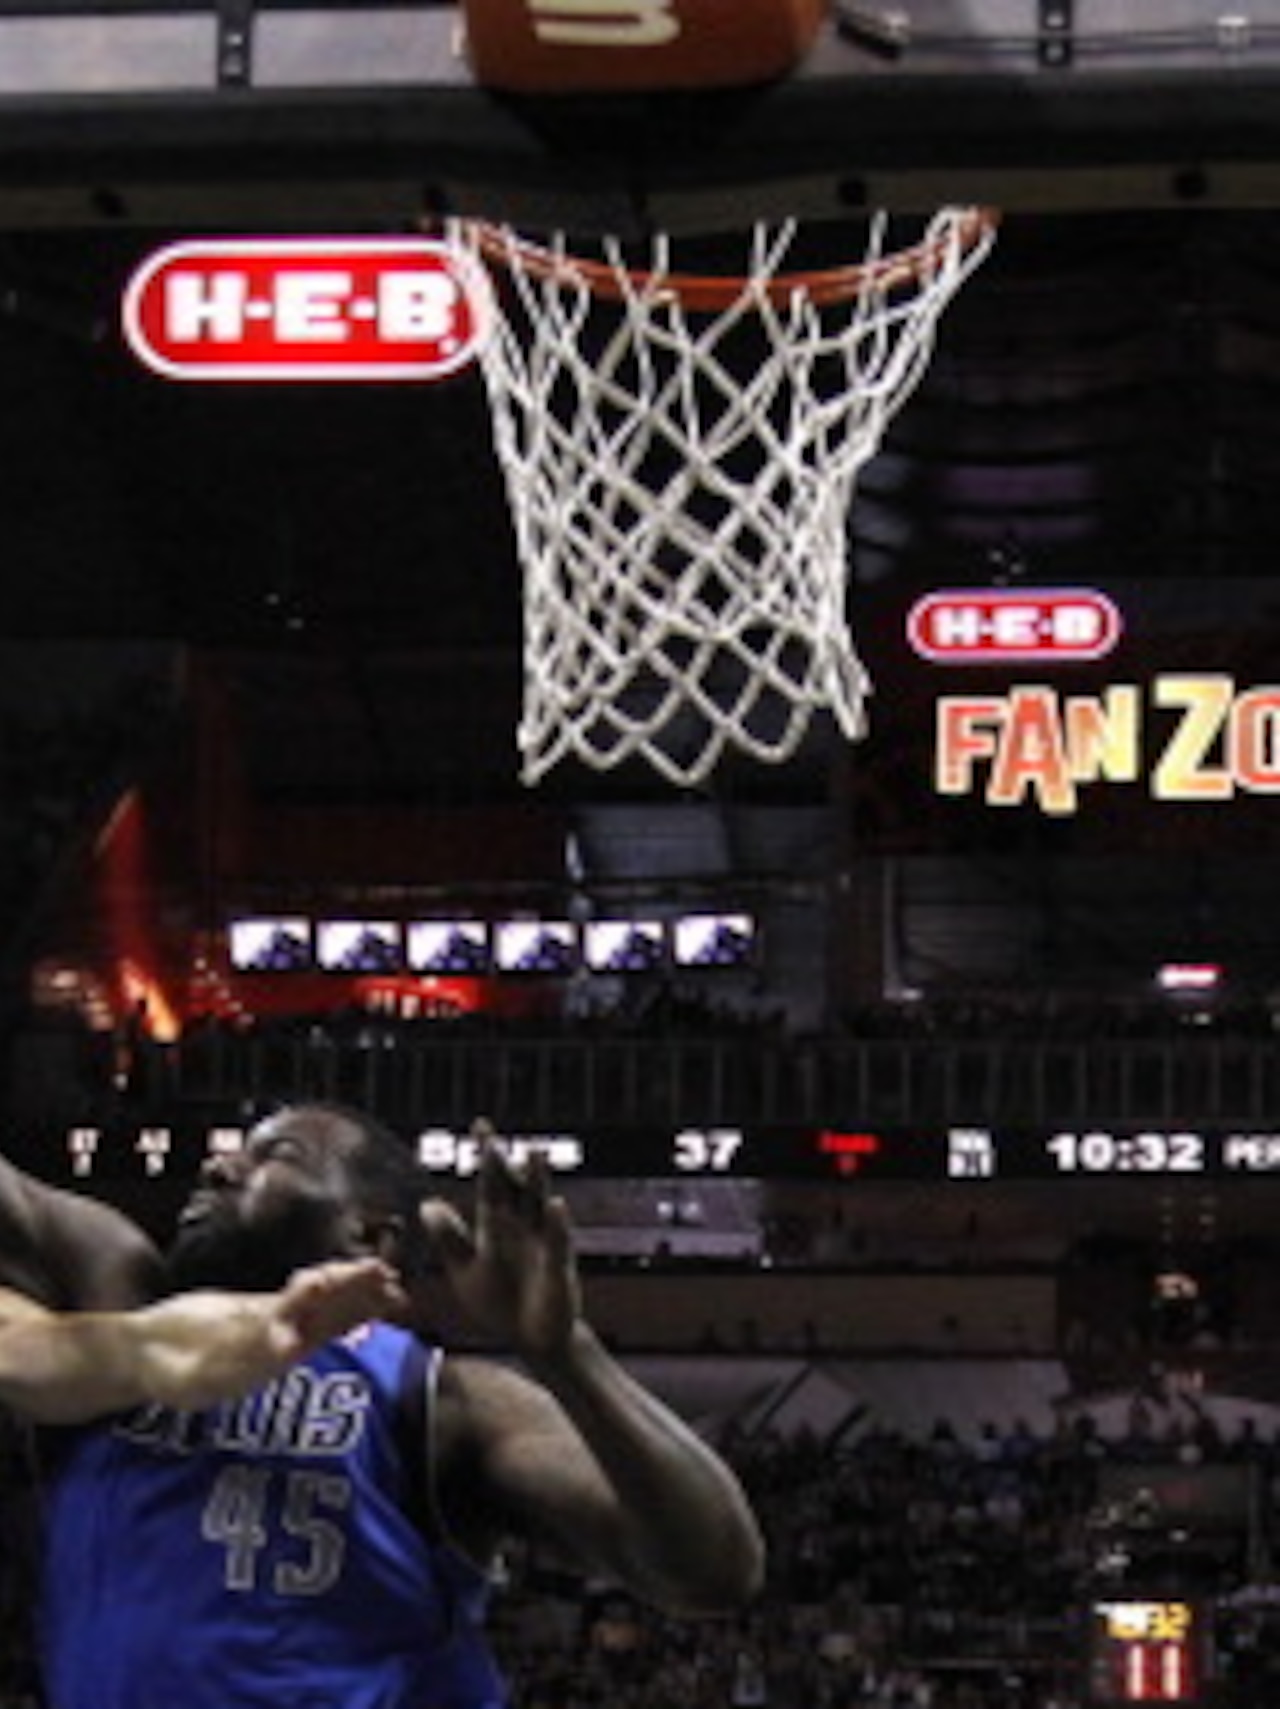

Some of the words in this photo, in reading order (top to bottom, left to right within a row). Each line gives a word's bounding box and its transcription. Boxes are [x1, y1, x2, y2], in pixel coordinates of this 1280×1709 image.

[936, 684, 1140, 816] FAN
[674, 1129, 743, 1170] 37
[1046, 1132, 1205, 1172] 10:32
[201, 1463, 351, 1596] 45
[1126, 1645, 1180, 1700] 11
